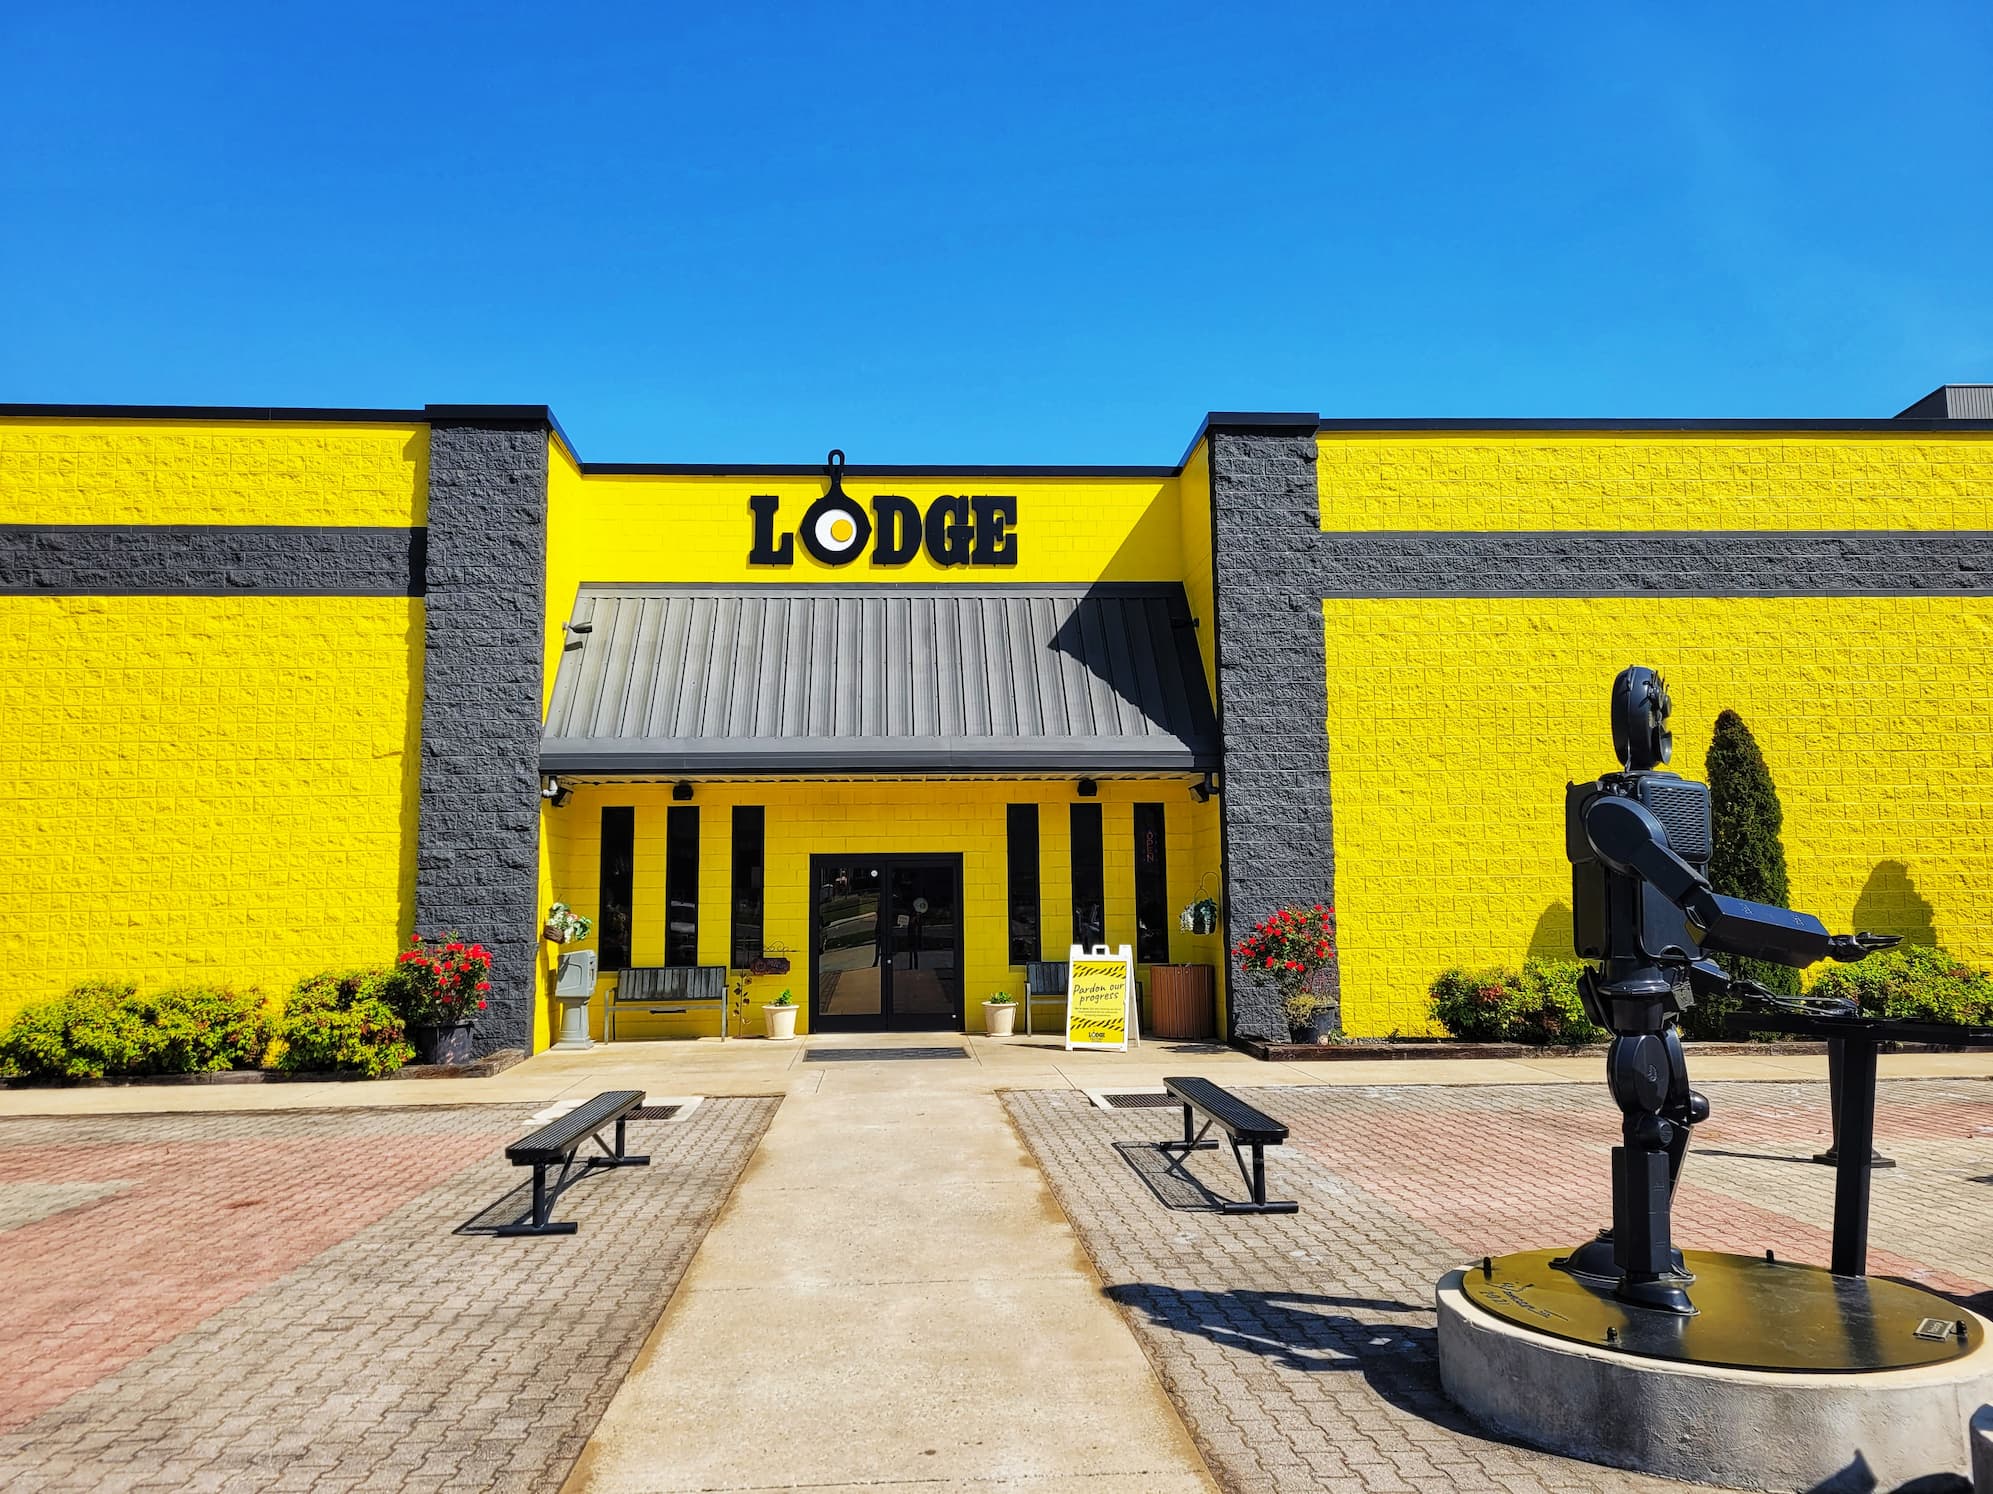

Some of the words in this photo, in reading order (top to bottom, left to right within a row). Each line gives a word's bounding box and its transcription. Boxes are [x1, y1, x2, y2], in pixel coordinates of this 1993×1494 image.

[750, 449, 1018, 567] LODGE
[1146, 831, 1154, 863] OPEN
[1073, 983, 1106, 996] Pardon
[1109, 983, 1124, 991] our
[1079, 992, 1119, 1006] progress
